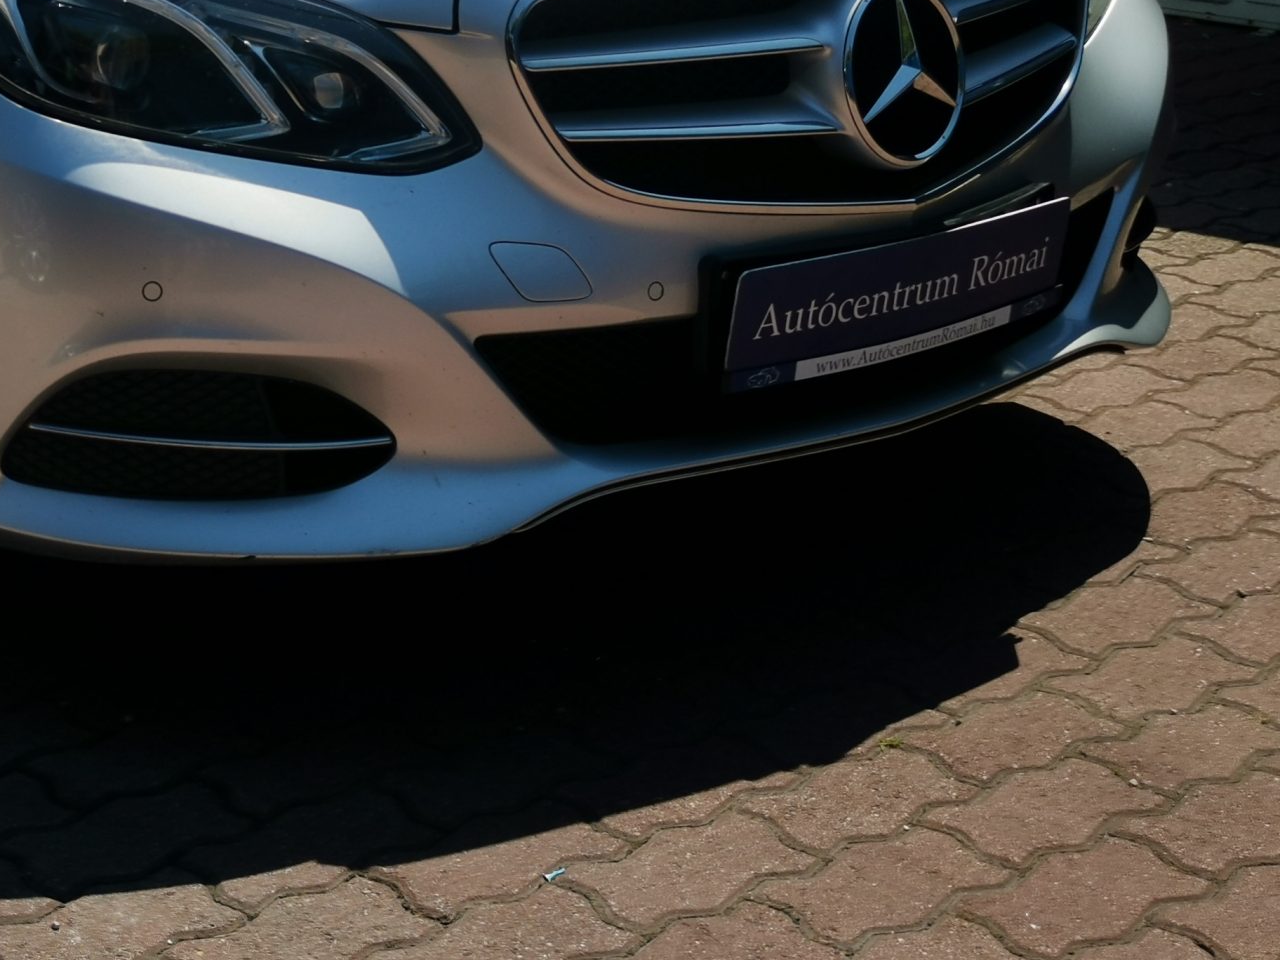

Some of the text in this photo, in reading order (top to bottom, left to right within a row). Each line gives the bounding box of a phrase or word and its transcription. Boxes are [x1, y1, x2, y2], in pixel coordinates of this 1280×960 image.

[753, 237, 1049, 340] Autócentrum Római
[816, 315, 996, 374] www.AutócentrumRómai.hu
